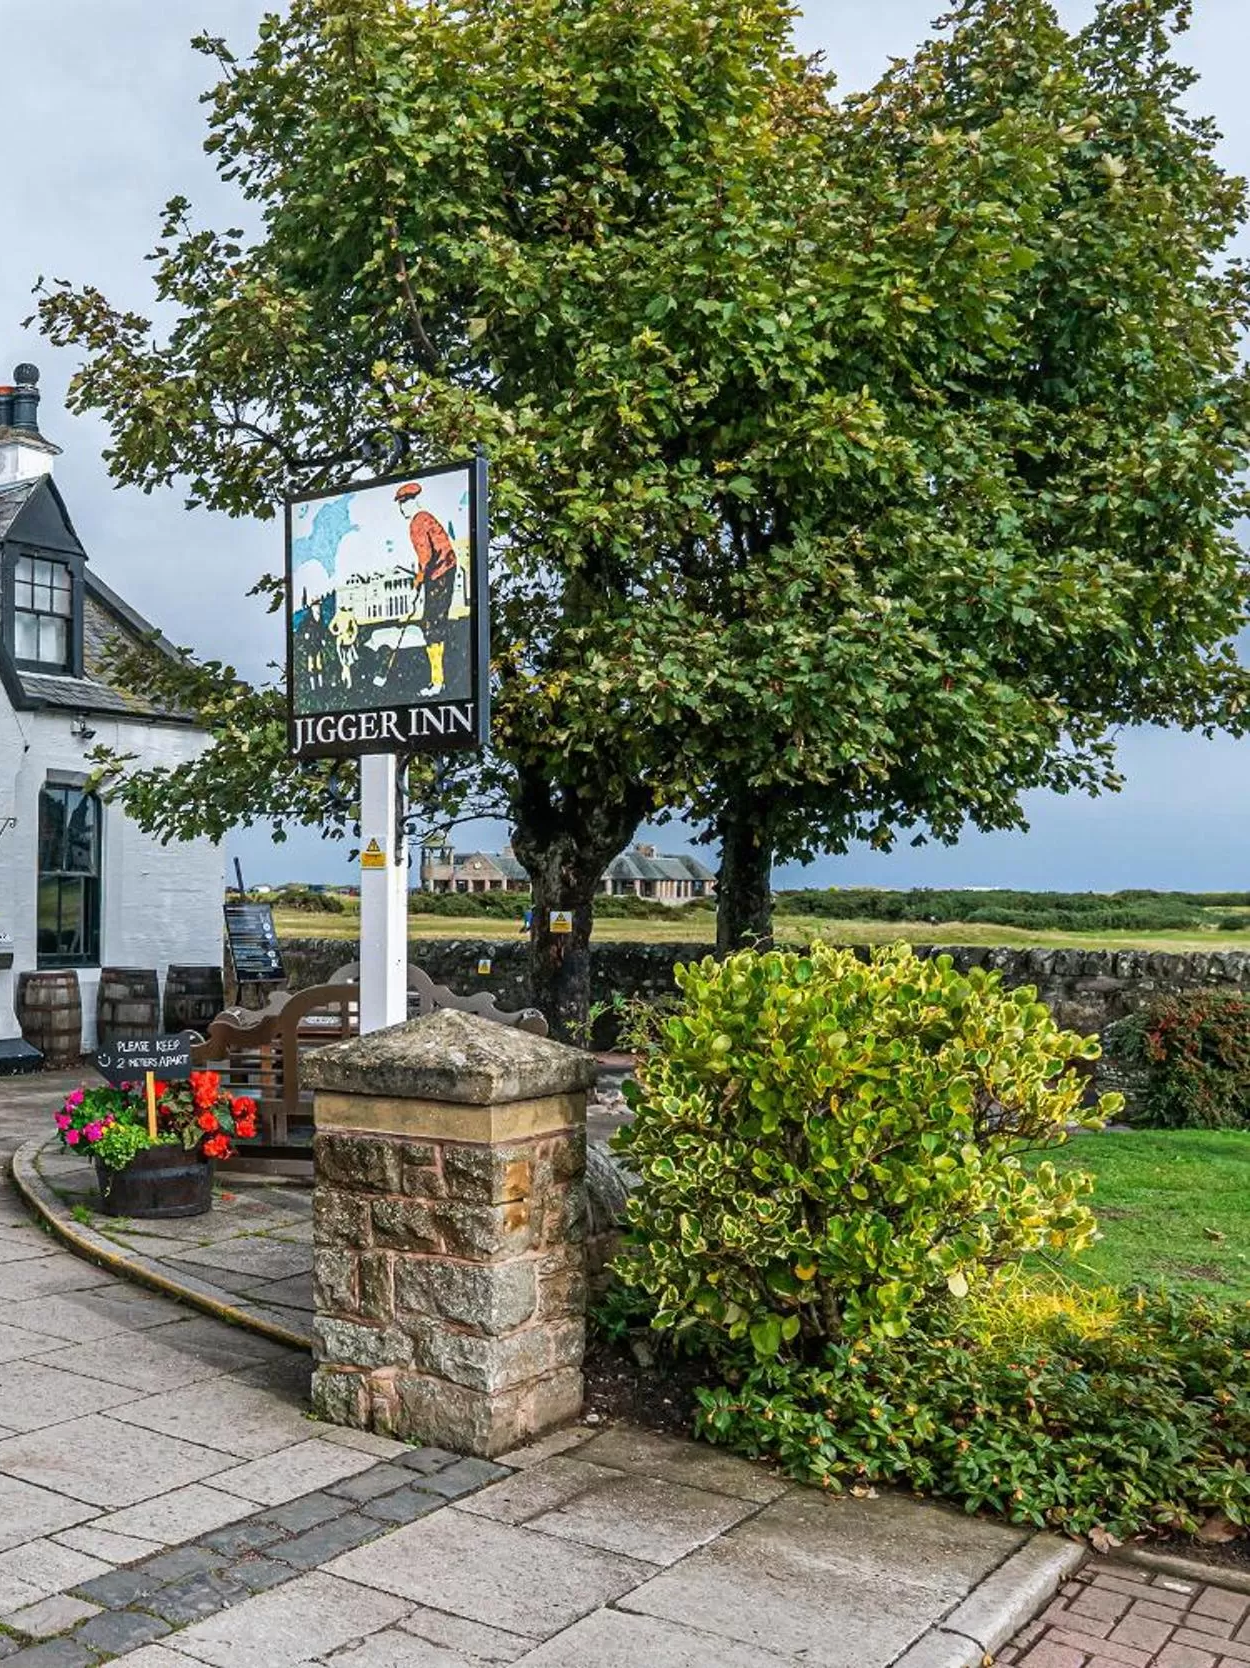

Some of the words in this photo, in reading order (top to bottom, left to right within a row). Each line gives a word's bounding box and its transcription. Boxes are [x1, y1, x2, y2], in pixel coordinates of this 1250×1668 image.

[292, 711, 407, 754] JIGGER
[407, 703, 474, 736] INN
[117, 1040, 150, 1052] PLEASE
[156, 1039, 180, 1052] KEEP
[116, 1058, 125, 1069] 2
[158, 1054, 189, 1067] APART
